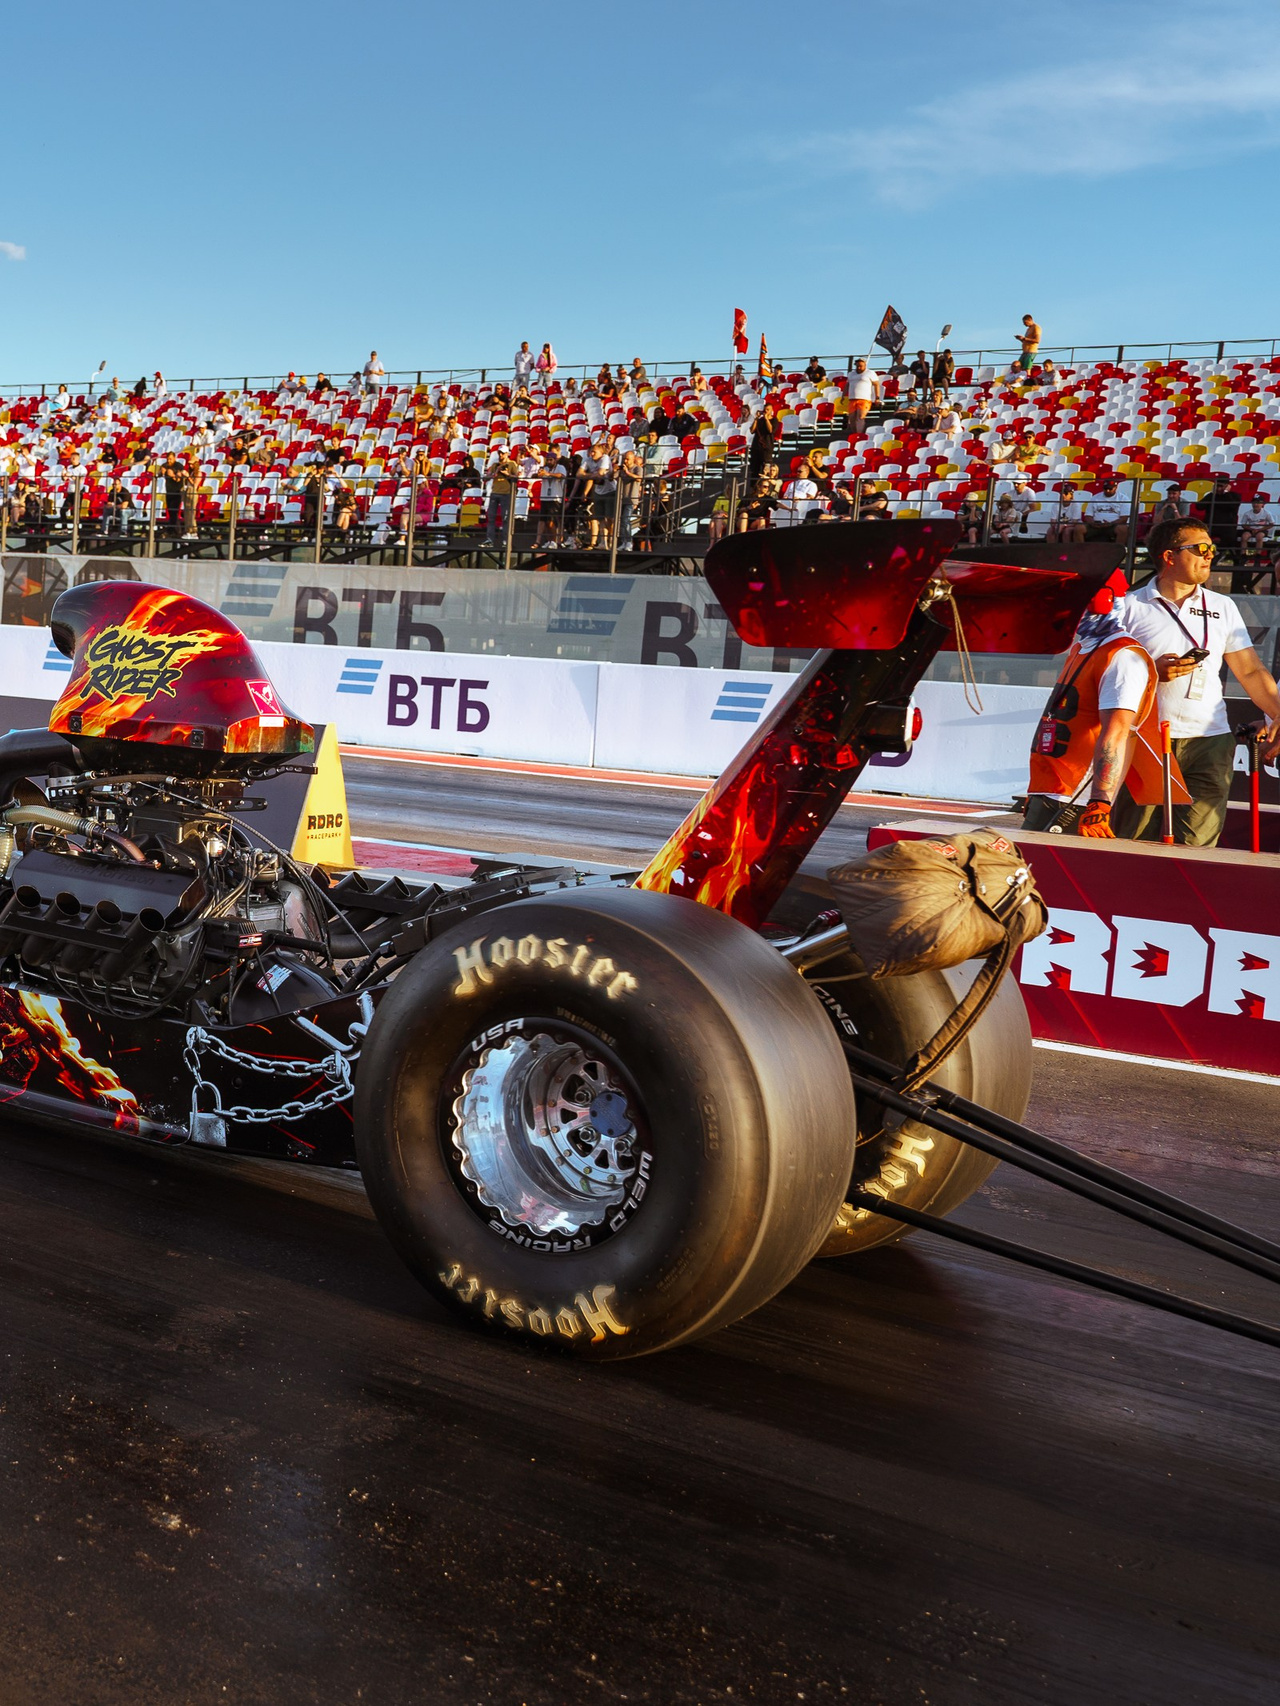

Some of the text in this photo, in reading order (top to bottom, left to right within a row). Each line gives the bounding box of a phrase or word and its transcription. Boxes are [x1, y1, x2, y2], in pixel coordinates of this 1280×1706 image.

[293, 586, 446, 652] ВТБ
[1189, 607, 1220, 619] RDRC
[89, 630, 198, 668] GHOST
[80, 665, 181, 700] RIDER
[387, 674, 490, 733] ВТБ
[308, 813, 343, 830] RDRC
[452, 933, 639, 999] Hoosier
[472, 1018, 524, 1052] USA
[488, 1151, 653, 1253] WELD RACING
[439, 1264, 631, 1344] Hoosier
